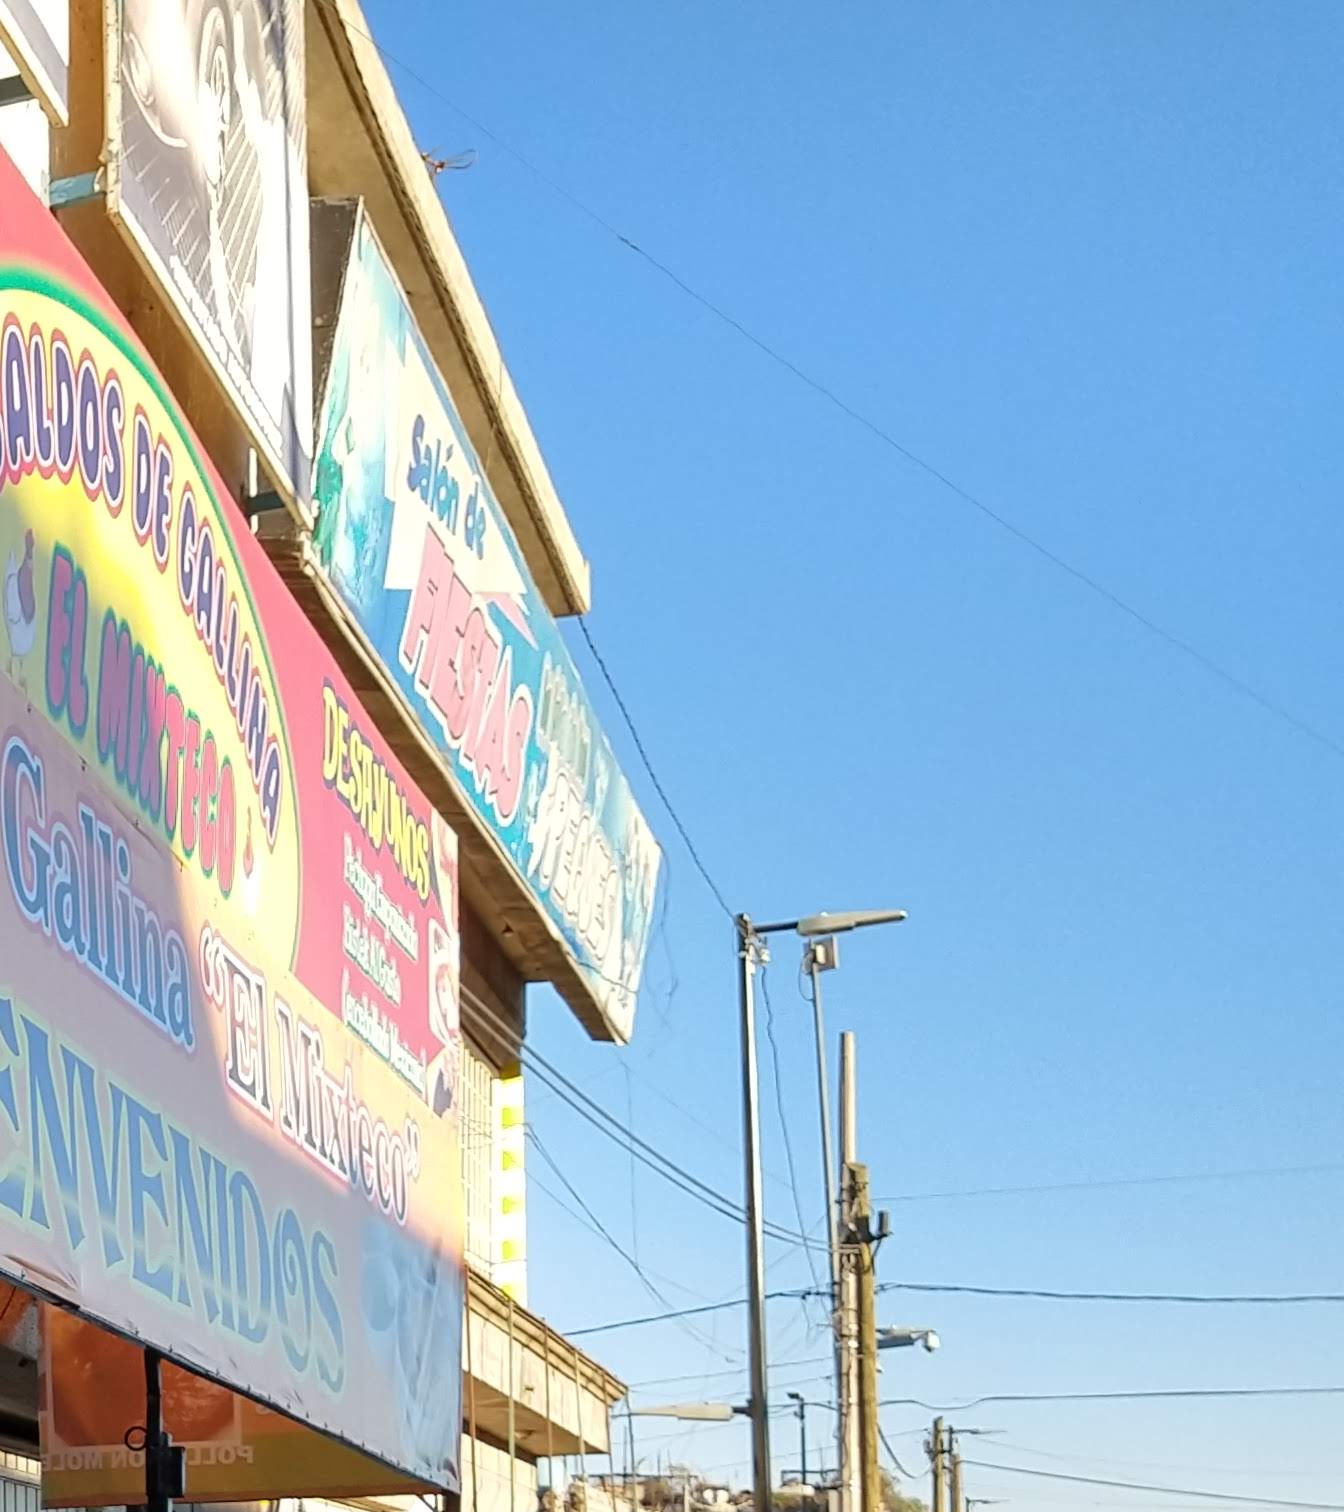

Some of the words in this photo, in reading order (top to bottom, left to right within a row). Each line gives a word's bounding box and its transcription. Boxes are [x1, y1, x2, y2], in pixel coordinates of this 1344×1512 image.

[133, 411, 172, 563] DE
[178, 492, 283, 847] GALLINA
[407, 414, 459, 536] Salón
[465, 480, 486, 560] de
[45, 543, 89, 736] EL
[98, 608, 236, 898] MIXTECO
[322, 684, 431, 903] DESAYUNOS
[400, 521, 531, 825] FIESTAS
[0, 736, 195, 1054] Gallina
